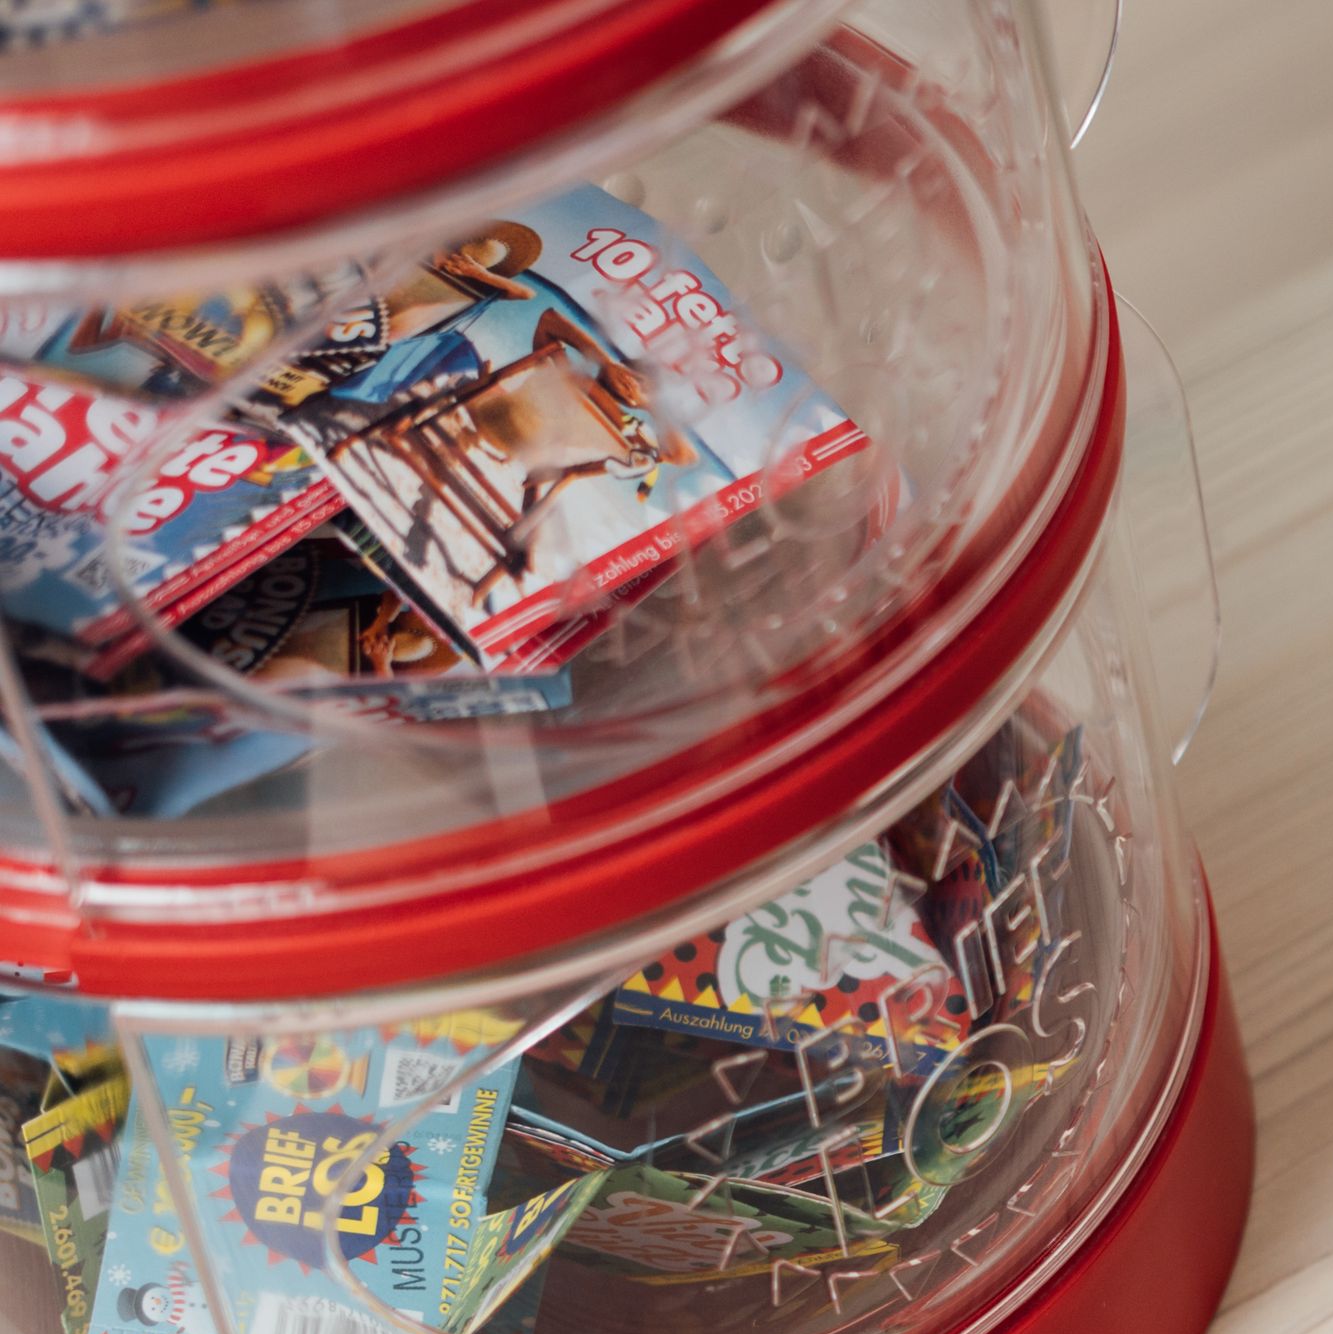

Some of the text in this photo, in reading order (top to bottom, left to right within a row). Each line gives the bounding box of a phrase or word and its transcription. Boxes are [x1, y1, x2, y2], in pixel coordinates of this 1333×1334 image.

[571, 228, 655, 284] 10
[659, 1006, 754, 1039] Auszahlung
[254, 1127, 317, 1226] BRIEF
